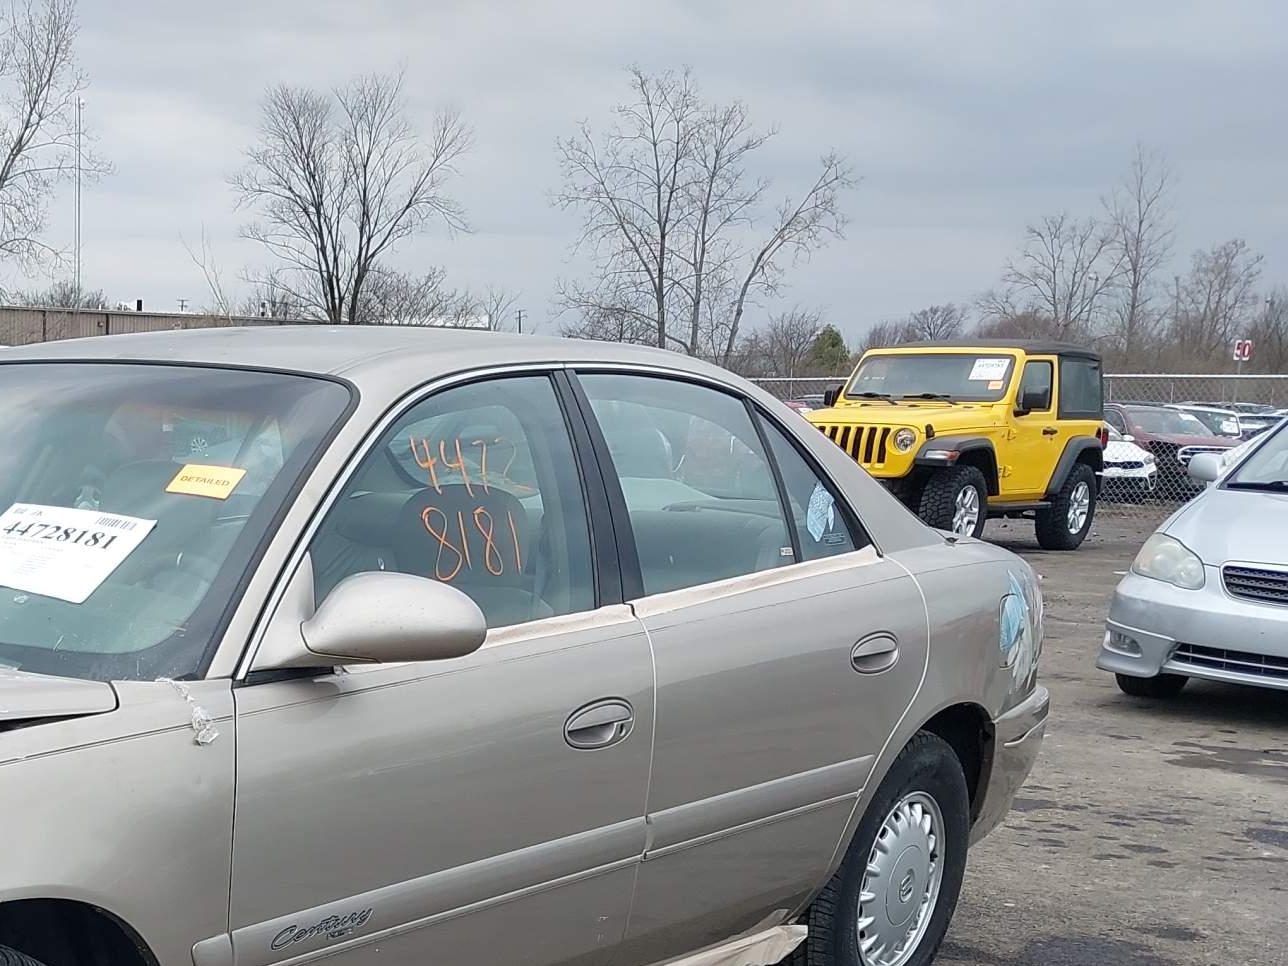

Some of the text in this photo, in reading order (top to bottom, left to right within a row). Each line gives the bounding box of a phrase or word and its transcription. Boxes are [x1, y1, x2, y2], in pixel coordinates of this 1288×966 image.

[1235, 342, 1252, 358] 50
[180, 475, 231, 487] DETAILED
[3, 520, 118, 550] 44728181
[420, 506, 523, 581] 8181
[271, 908, 374, 952] Century
